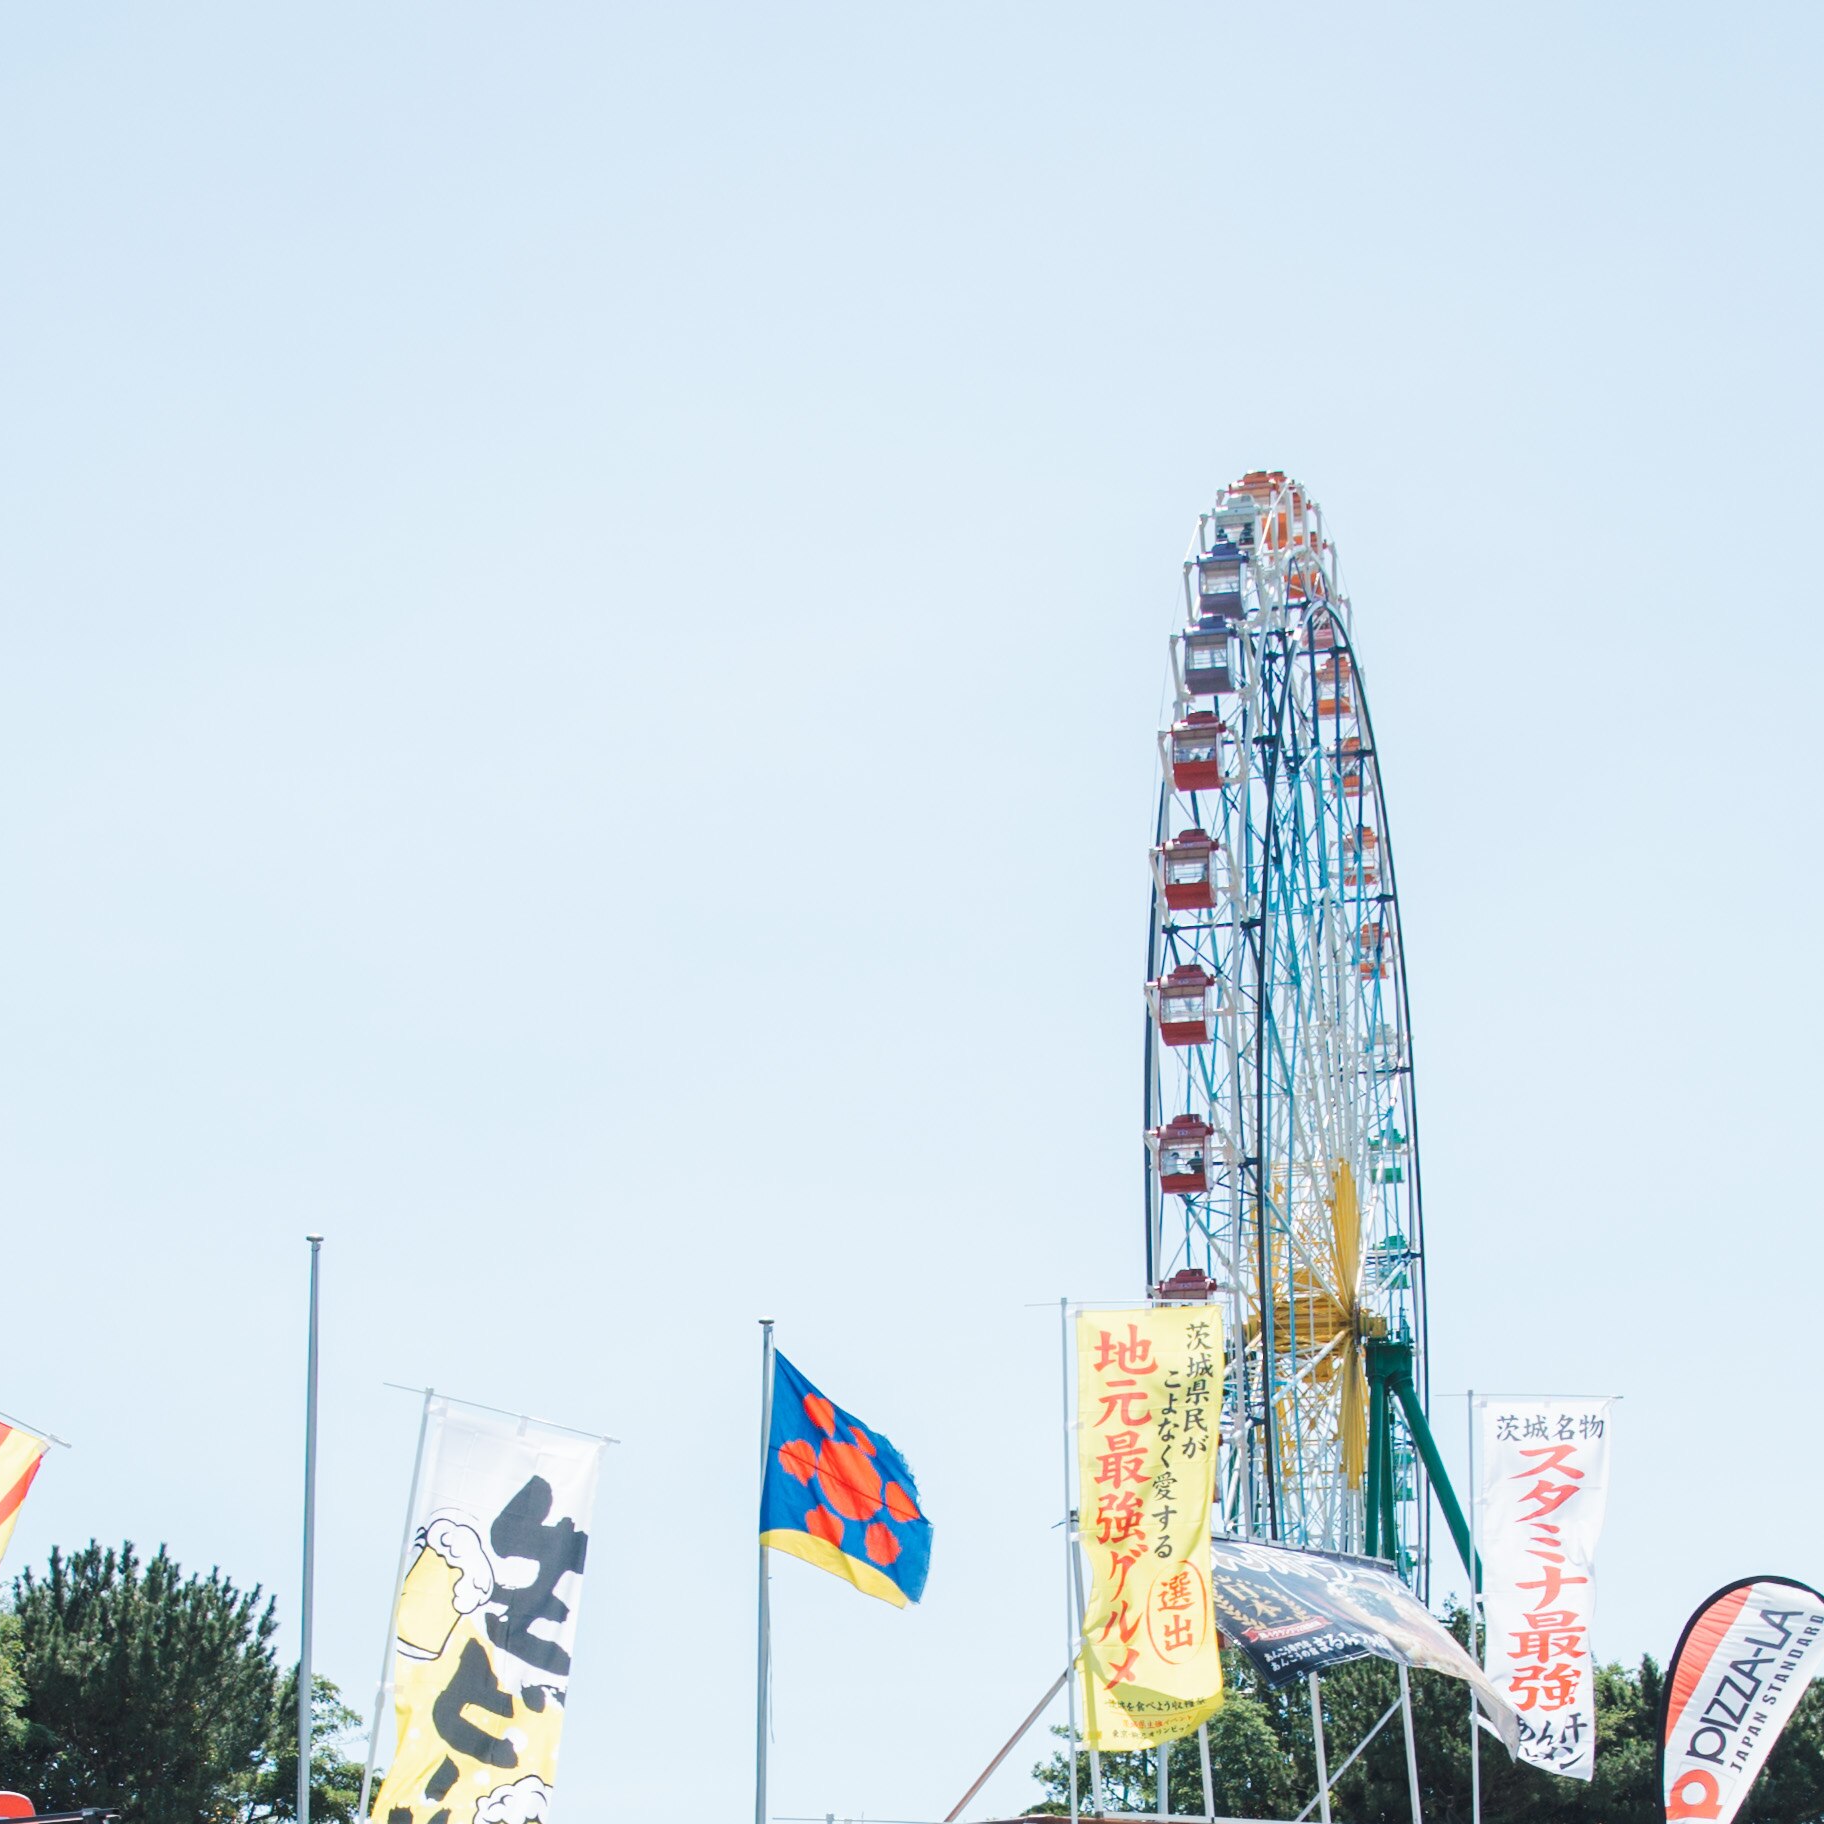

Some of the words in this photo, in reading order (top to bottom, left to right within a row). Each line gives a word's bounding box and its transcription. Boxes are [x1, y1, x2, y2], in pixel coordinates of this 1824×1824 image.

[1182, 1322, 1214, 1459] 茨城県民が
[1496, 1413, 1604, 1442] 茨城名物
[1093, 1324, 1159, 1691] 地元最強グルメ
[1152, 1370, 1182, 1560] こよなく愛する
[1157, 1571, 1195, 1652] 選出
[1729, 1711, 1768, 1774] JAPAN
